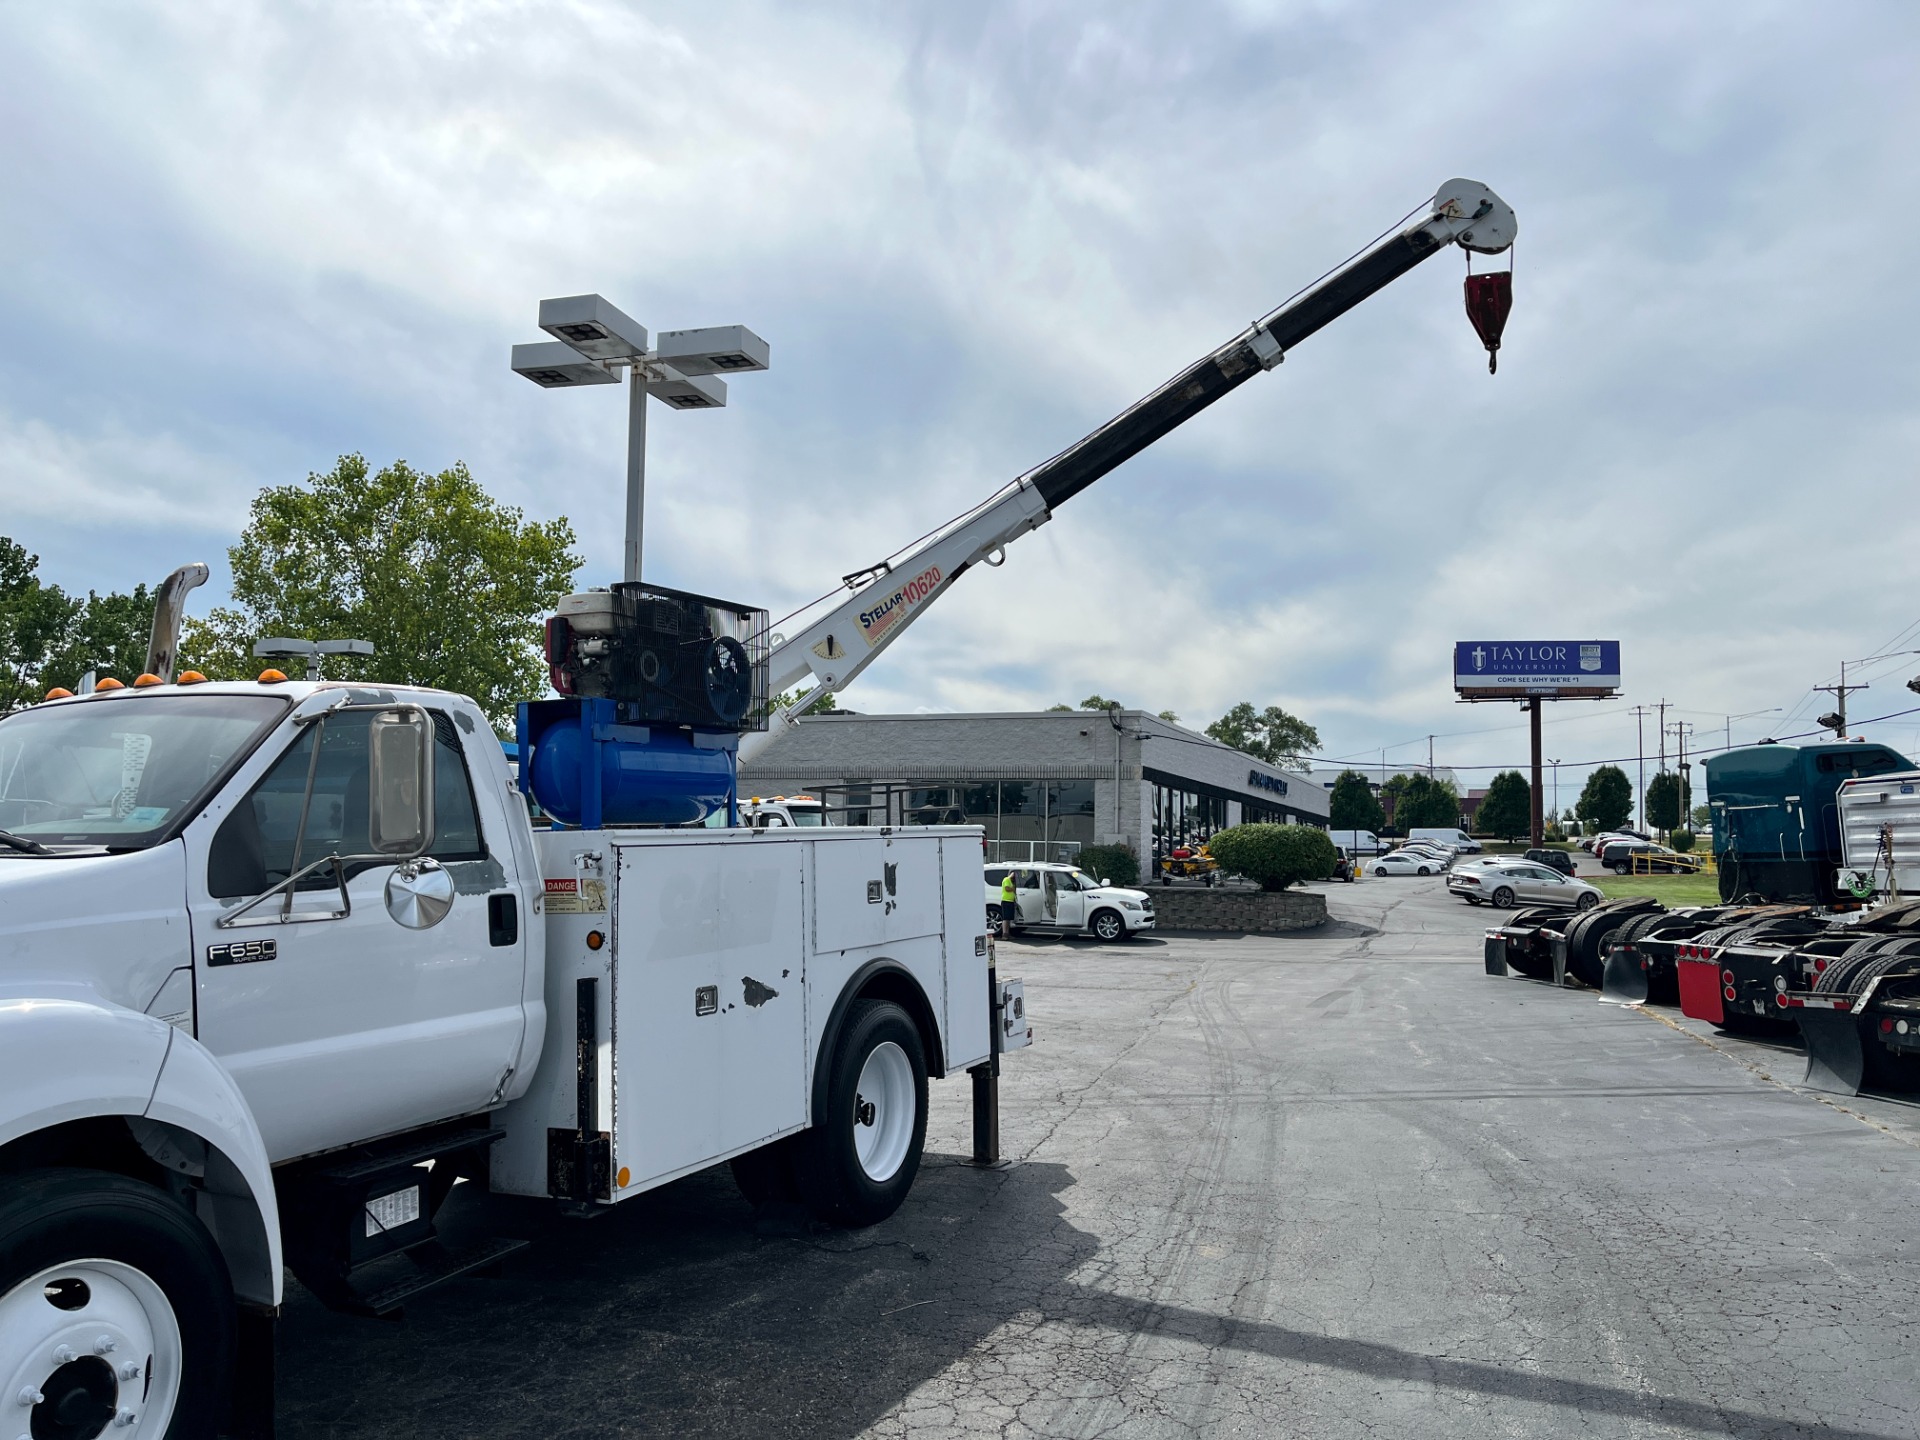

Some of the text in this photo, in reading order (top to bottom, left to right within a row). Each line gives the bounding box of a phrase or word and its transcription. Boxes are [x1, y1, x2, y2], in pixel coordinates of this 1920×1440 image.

[860, 567, 941, 628] STELLAR 10620
[1490, 646, 1566, 661] TAYLOR
[547, 881, 576, 891] DANGE
